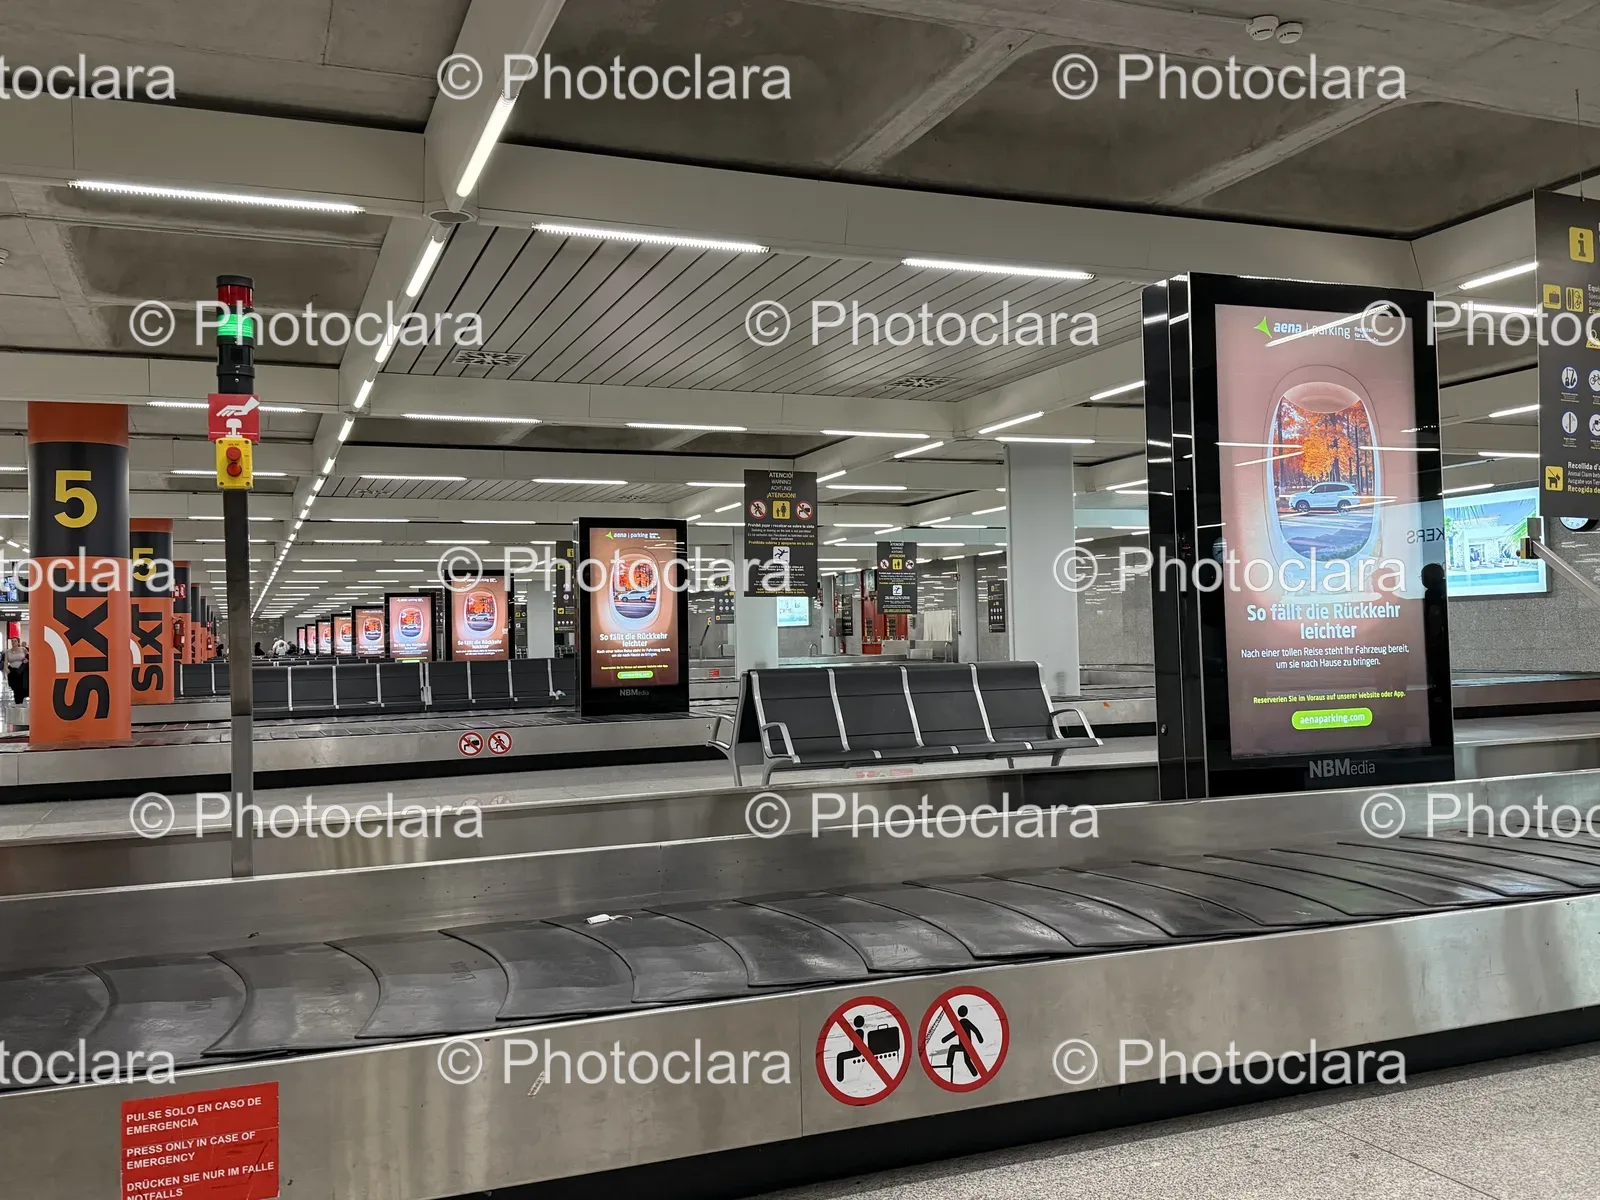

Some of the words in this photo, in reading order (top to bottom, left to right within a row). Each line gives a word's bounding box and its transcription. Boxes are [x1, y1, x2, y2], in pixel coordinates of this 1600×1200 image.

[1274, 321, 1302, 334] aena
[1568, 462, 1593, 470] Recollida
[1568, 485, 1593, 494] Recogida
[54, 470, 98, 528] 5
[132, 548, 157, 582] 5
[1247, 605, 1266, 621] So
[1270, 604, 1302, 621] fällt
[1306, 604, 1328, 619] die
[1333, 602, 1400, 619] Rückkehr
[1300, 622, 1357, 639] leichter
[44, 567, 110, 720] SIXT
[131, 604, 164, 691] SIXT
[1241, 649, 1260, 658] Nach
[1261, 649, 1280, 657] einer
[1282, 647, 1302, 657] tollen
[1304, 647, 1323, 656] Reise
[1325, 646, 1343, 655] steht
[1355, 645, 1387, 656] Fahrzeug
[1276, 660, 1287, 669] um
[1289, 659, 1299, 668] sie
[1301, 658, 1318, 668] nach
[1320, 658, 1341, 667] Hause
[1352, 657, 1380, 668] bringen.
[1300, 713, 1365, 724] aenaparking.com
[1309, 758, 1376, 778] NBMedia
[126, 1110, 162, 1122] PULSE
[165, 1106, 194, 1118] SOLO
[198, 1104, 212, 1113] EN
[215, 1099, 244, 1110] CASO
[247, 1097, 261, 1106] DE
[126, 1118, 198, 1135] EMERGENCIA
[126, 1145, 162, 1157] PRESS
[165, 1140, 194, 1152] ONLY
[197, 1138, 206, 1147] IN
[210, 1133, 238, 1145] CASE
[242, 1131, 255, 1140] OF
[126, 1152, 195, 1169] EMERGENCY
[126, 1176, 180, 1192] DRÜCKEN
[183, 1173, 199, 1182] SIE
[203, 1170, 225, 1180] NUR
[228, 1167, 239, 1176] IM
[242, 1162, 274, 1173] FALLE
